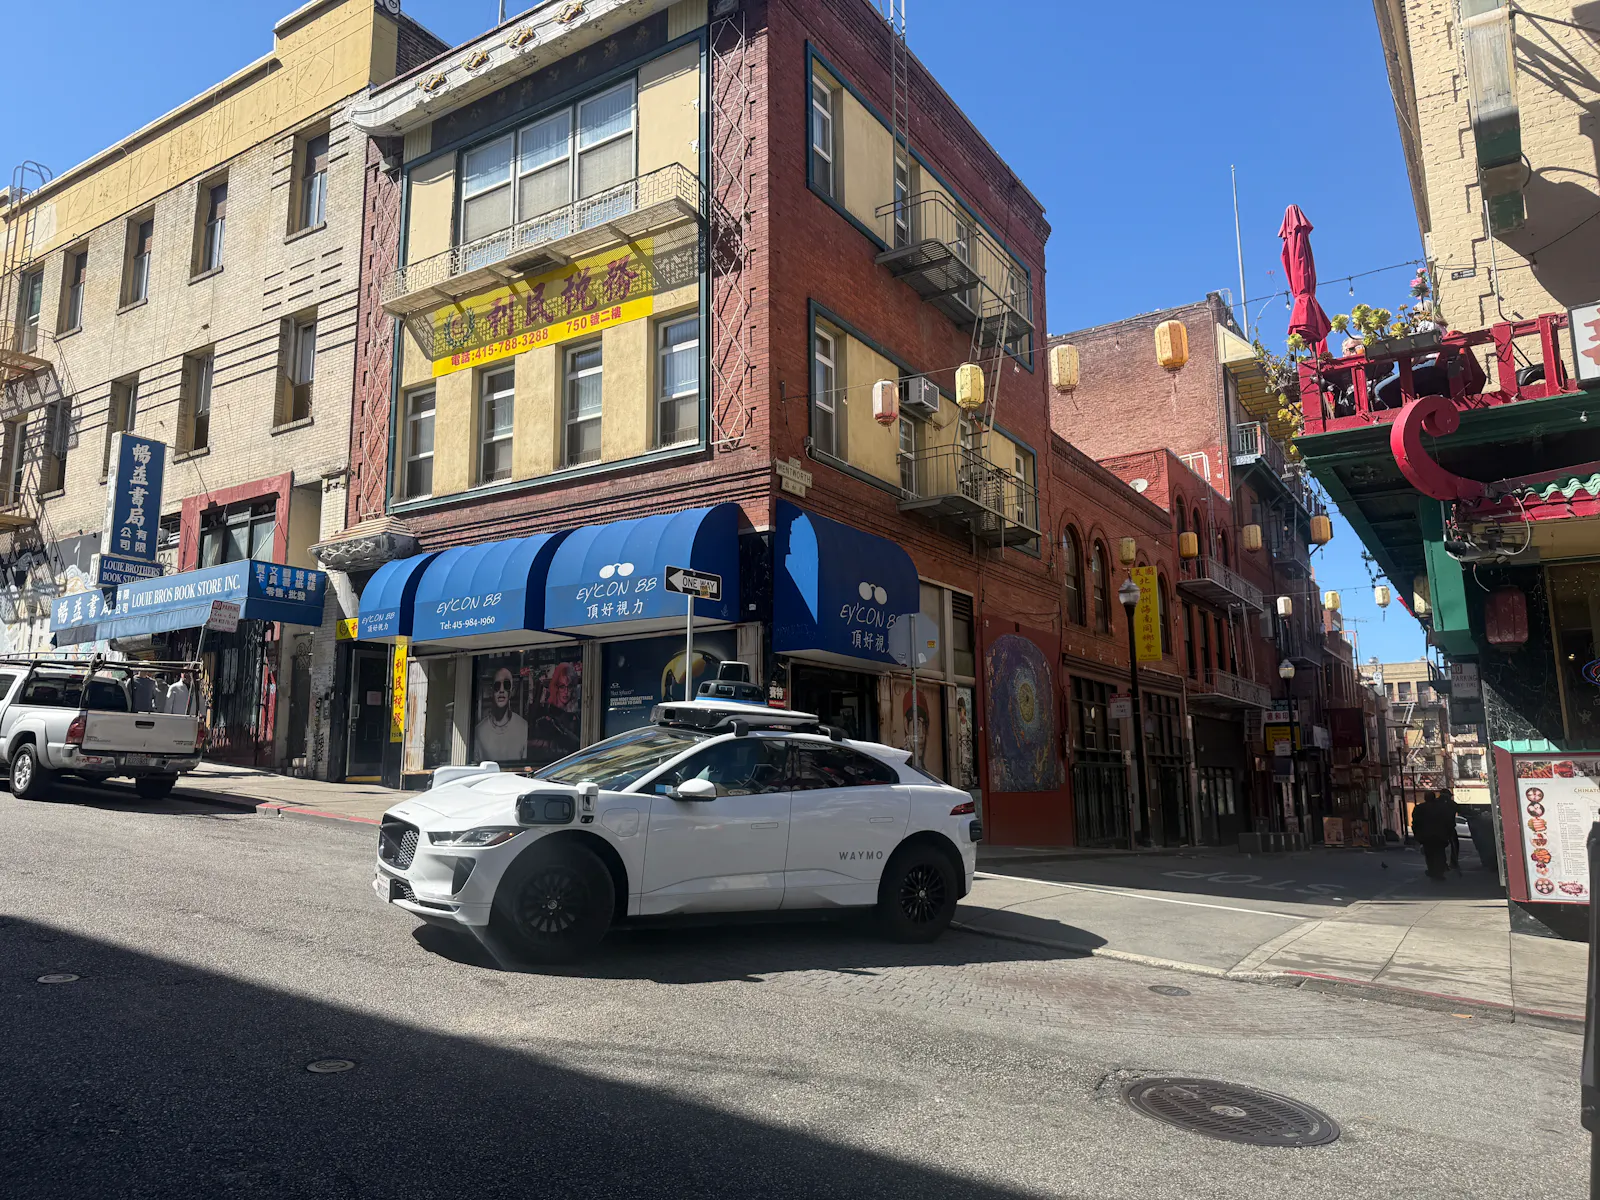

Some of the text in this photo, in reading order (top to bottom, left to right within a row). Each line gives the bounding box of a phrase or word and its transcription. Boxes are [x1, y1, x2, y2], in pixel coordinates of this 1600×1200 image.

[777, 462, 811, 484] WENTWORTH
[119, 526, 132, 551] 公司
[134, 528, 148, 553] 有限
[102, 572, 122, 583] BOOK
[103, 560, 125, 572] LOUIE
[125, 564, 160, 577] BROTHERS
[131, 573, 241, 608] LOUIE BROS BOOK STORE INC.
[576, 577, 658, 604] EY'CON 88
[682, 576, 698, 588] ONE
[700, 579, 716, 592] WAY
[116, 589, 130, 601] 有限
[436, 592, 502, 616] EY'CON 88
[115, 603, 129, 615] 公司
[586, 598, 644, 619] 頂好視力
[840, 602, 885, 628] EY'CON
[851, 629, 889, 653] 頂好視
[1452, 664, 1461, 673] NO
[1452, 674, 1477, 682] PARKING
[838, 850, 884, 861] WAYMO
[1160, 870, 1346, 896] STOP
